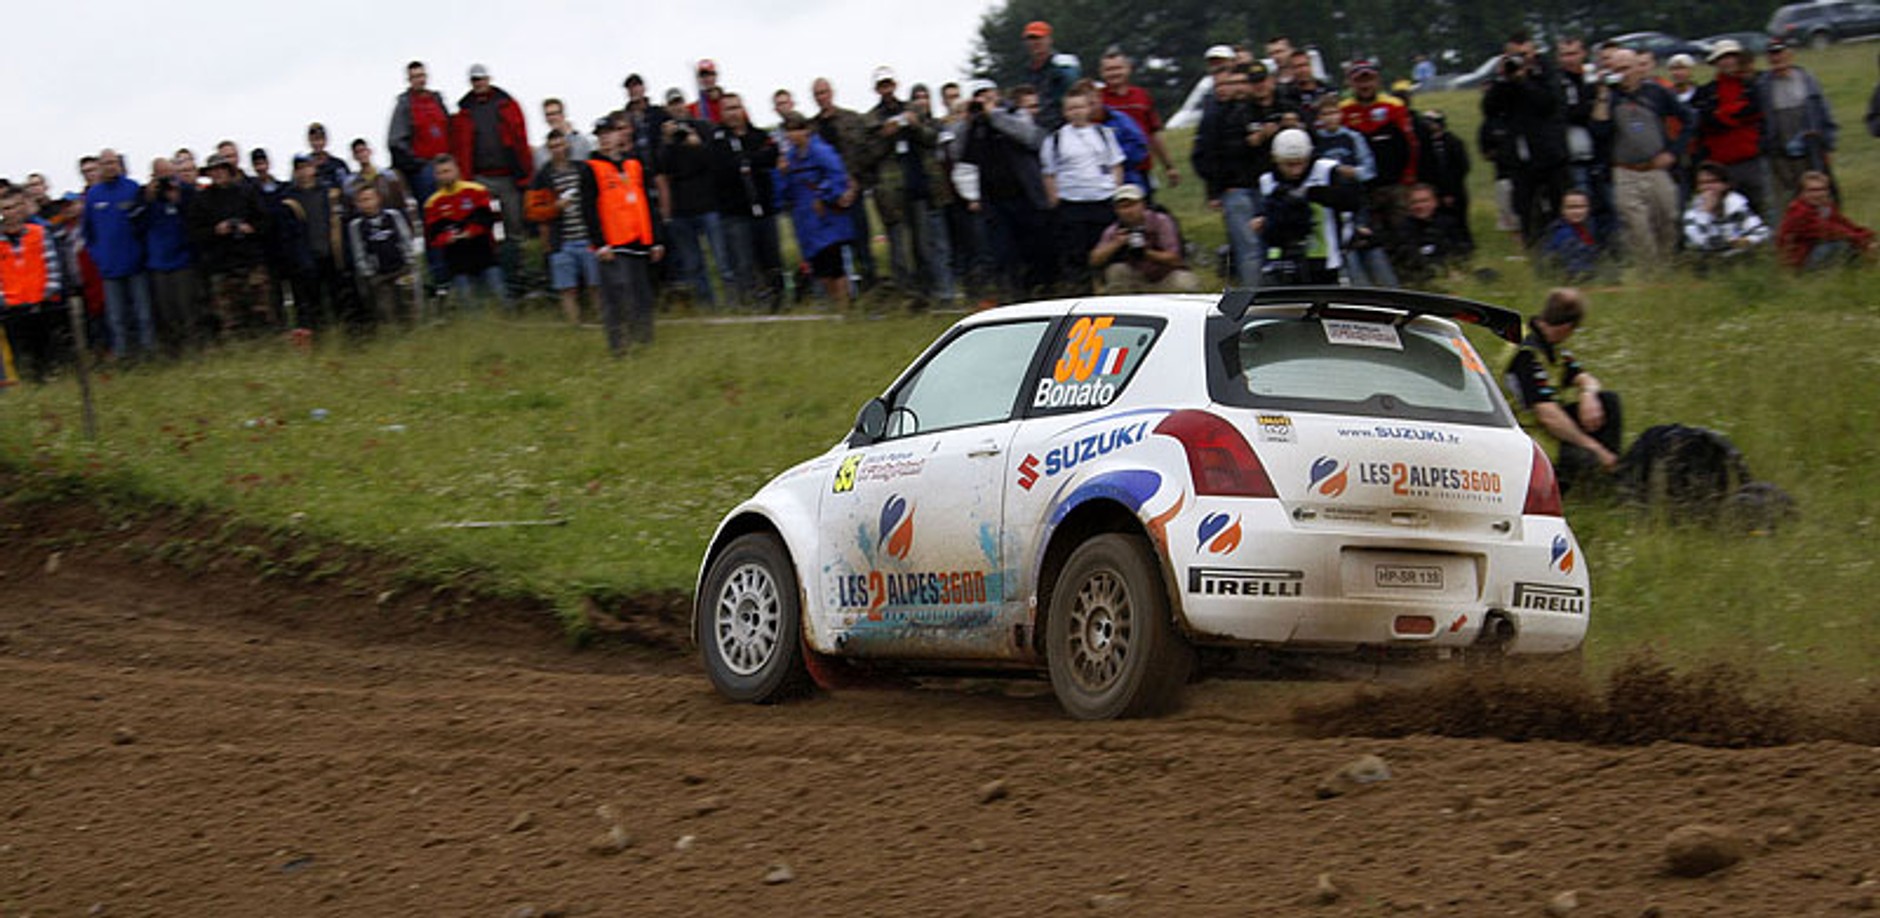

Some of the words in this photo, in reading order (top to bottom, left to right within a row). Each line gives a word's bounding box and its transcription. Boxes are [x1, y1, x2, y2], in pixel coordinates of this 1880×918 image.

[1053, 316, 1115, 383] 35
[1033, 378, 1115, 407] Bonato
[1045, 421, 1150, 476] SUZUKI
[1188, 566, 1304, 597] PIRELLI
[1512, 582, 1584, 614] PIRELLI
